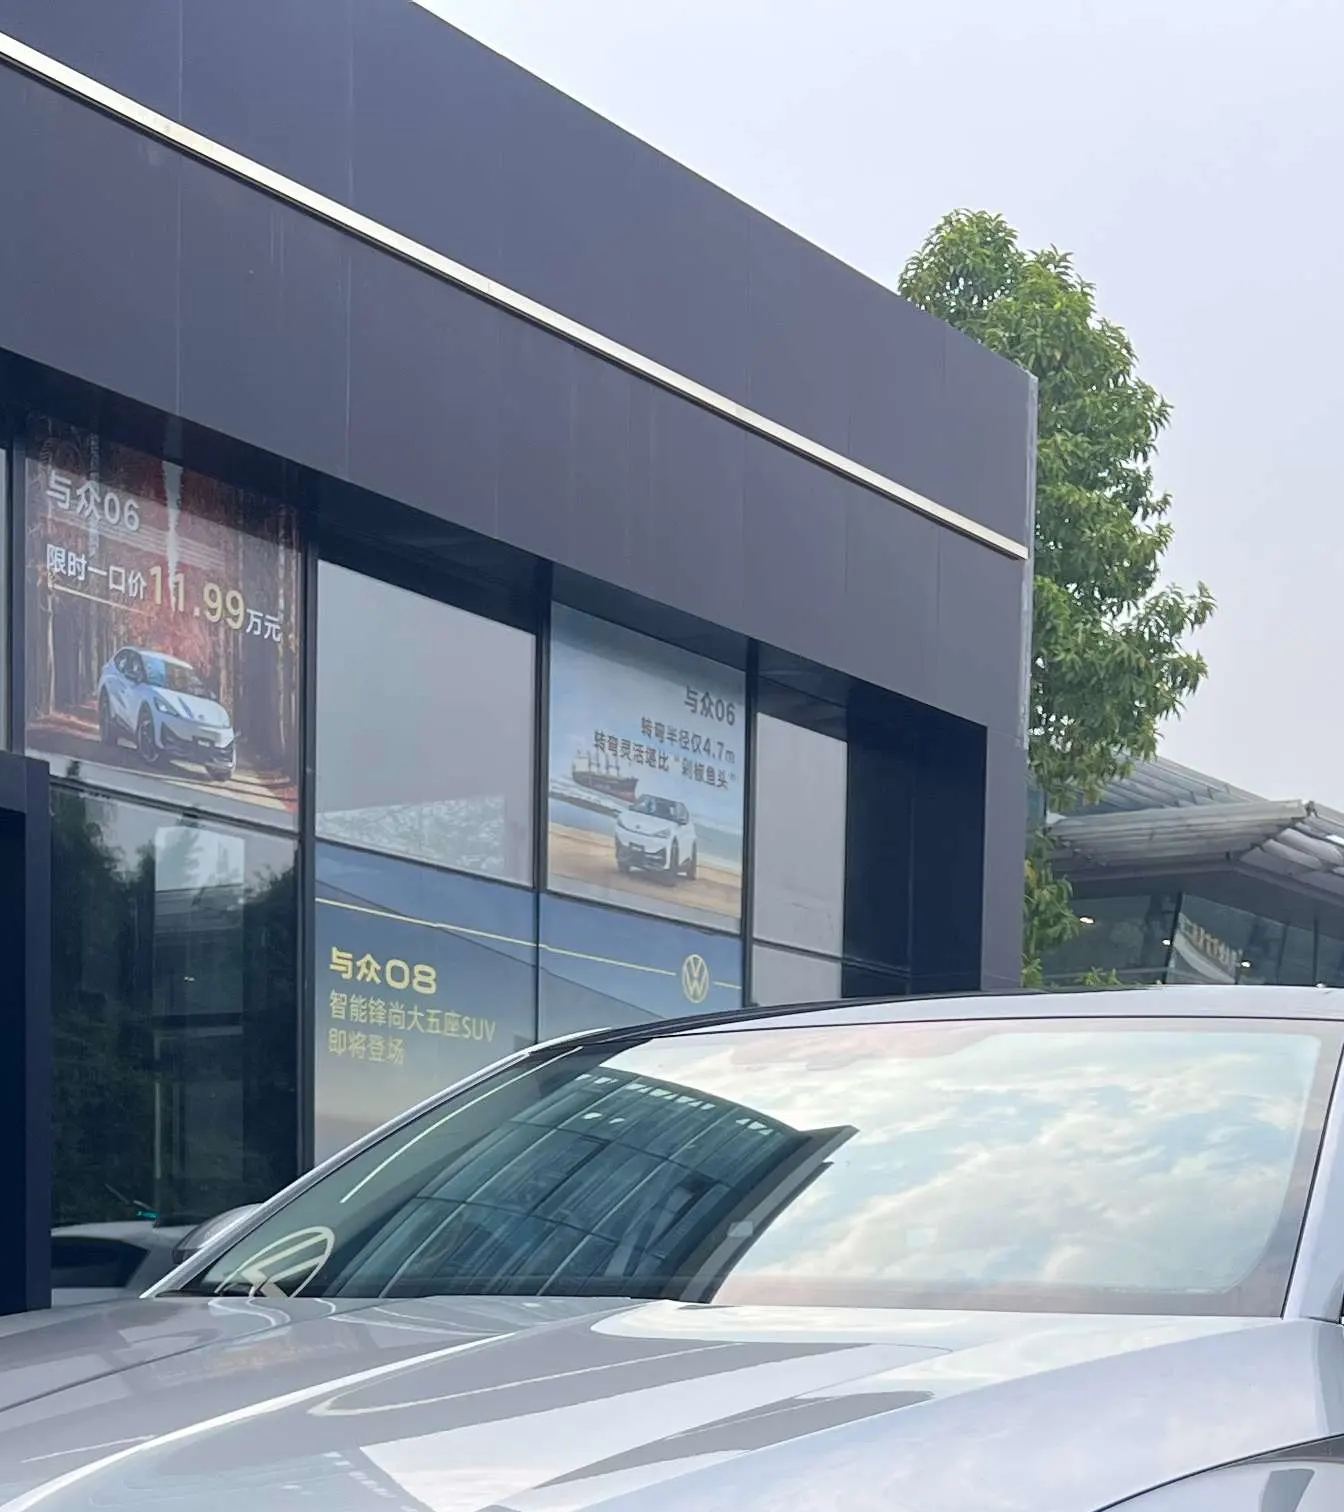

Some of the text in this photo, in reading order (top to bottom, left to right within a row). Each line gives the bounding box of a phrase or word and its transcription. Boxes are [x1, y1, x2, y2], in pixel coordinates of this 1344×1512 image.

[329, 989, 496, 1043] 智能锋尚大五座SUV
[328, 1027, 406, 1066] 即将登场
